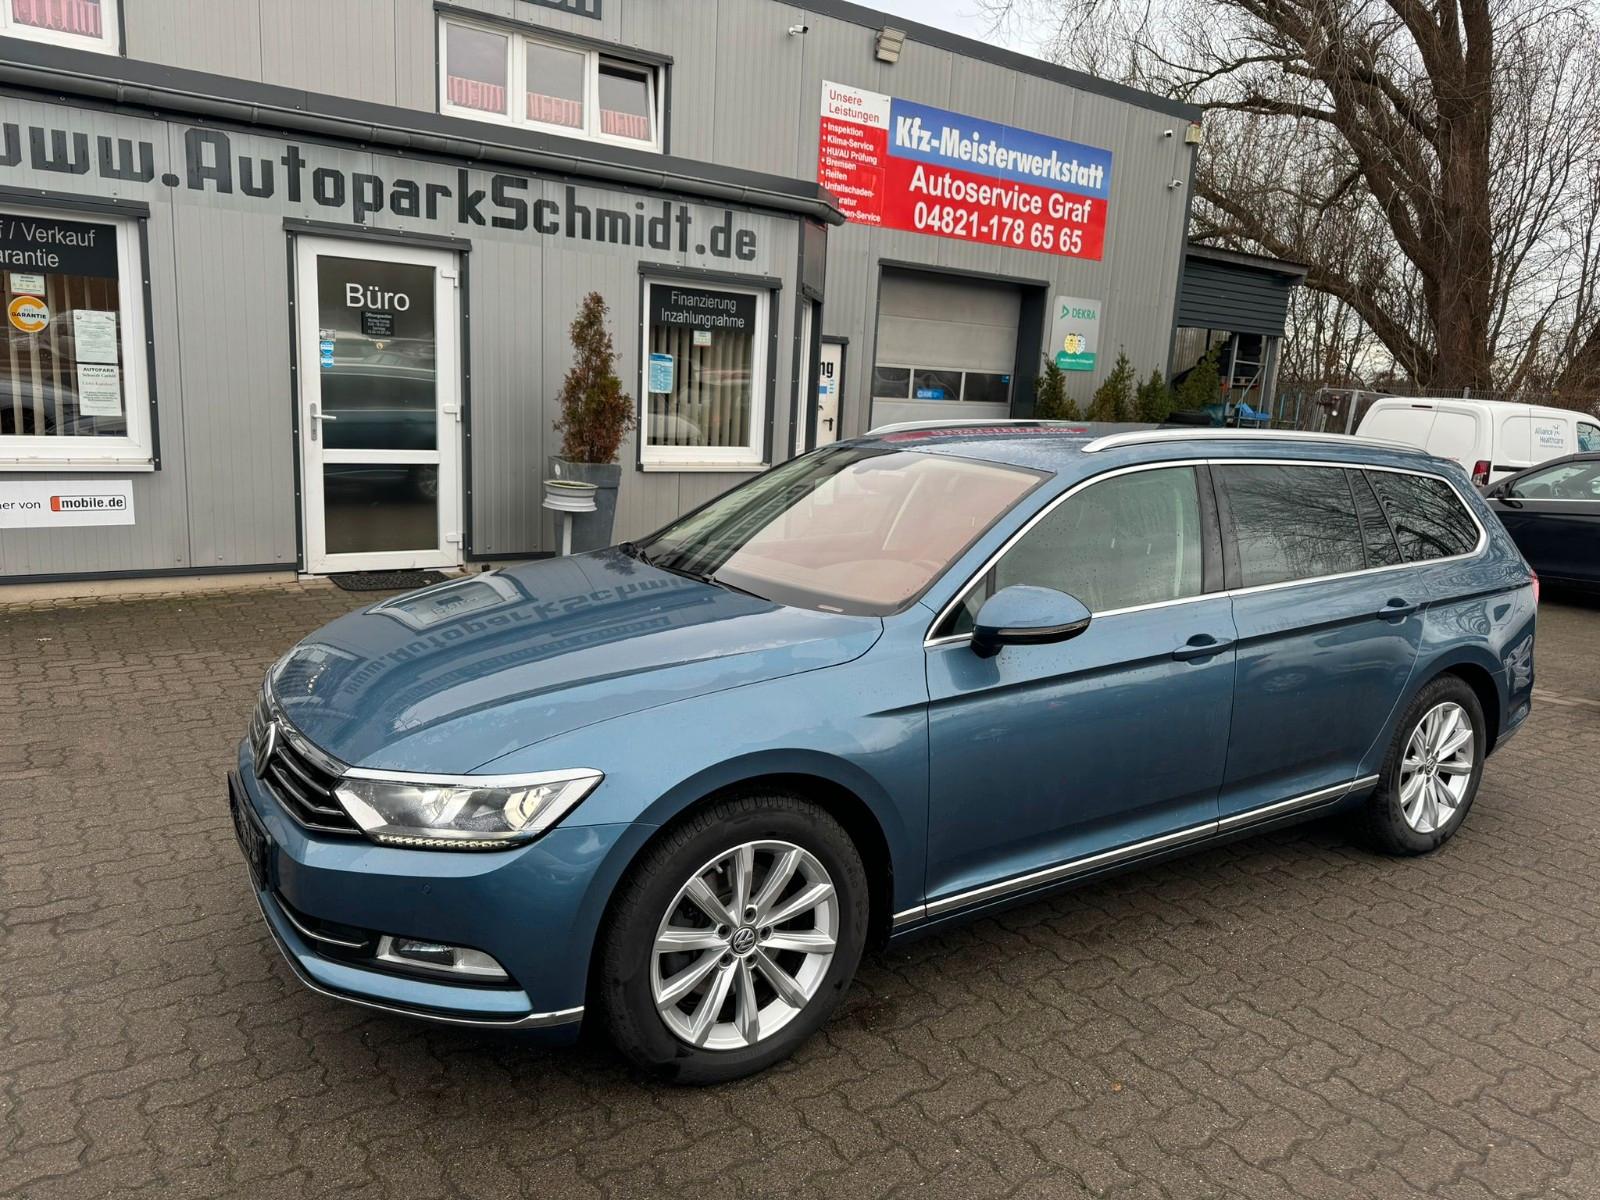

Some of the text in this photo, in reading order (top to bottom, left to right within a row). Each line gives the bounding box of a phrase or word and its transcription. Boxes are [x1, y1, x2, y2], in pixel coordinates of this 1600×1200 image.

[829, 89, 863, 106] Unsere
[828, 102, 880, 123] Leistungen
[827, 122, 864, 138] Inspektion
[827, 135, 875, 152] Klima-Service
[895, 115, 1104, 189] Kfz-Meisterwerkstatt
[825, 157, 857, 171] Bremsen
[826, 147, 878, 166] HU/AU Prüfung
[825, 168, 848, 181] Reifen
[824, 181, 875, 198] Unfallschaden-
[908, 165, 1092, 223] Autoservice Graf
[21, 222, 96, 247] Verkauf
[913, 201, 1083, 254] 04821-178 65 65
[345, 282, 410, 311] Büro
[671, 291, 737, 313] Finanzierung
[11, 311, 47, 320] GARANTIE
[661, 307, 745, 329] Inzahlungnahme
[1071, 307, 1096, 320] DEKRA
[18, 501, 41, 510] von
[61, 497, 124, 509] mobile.de
